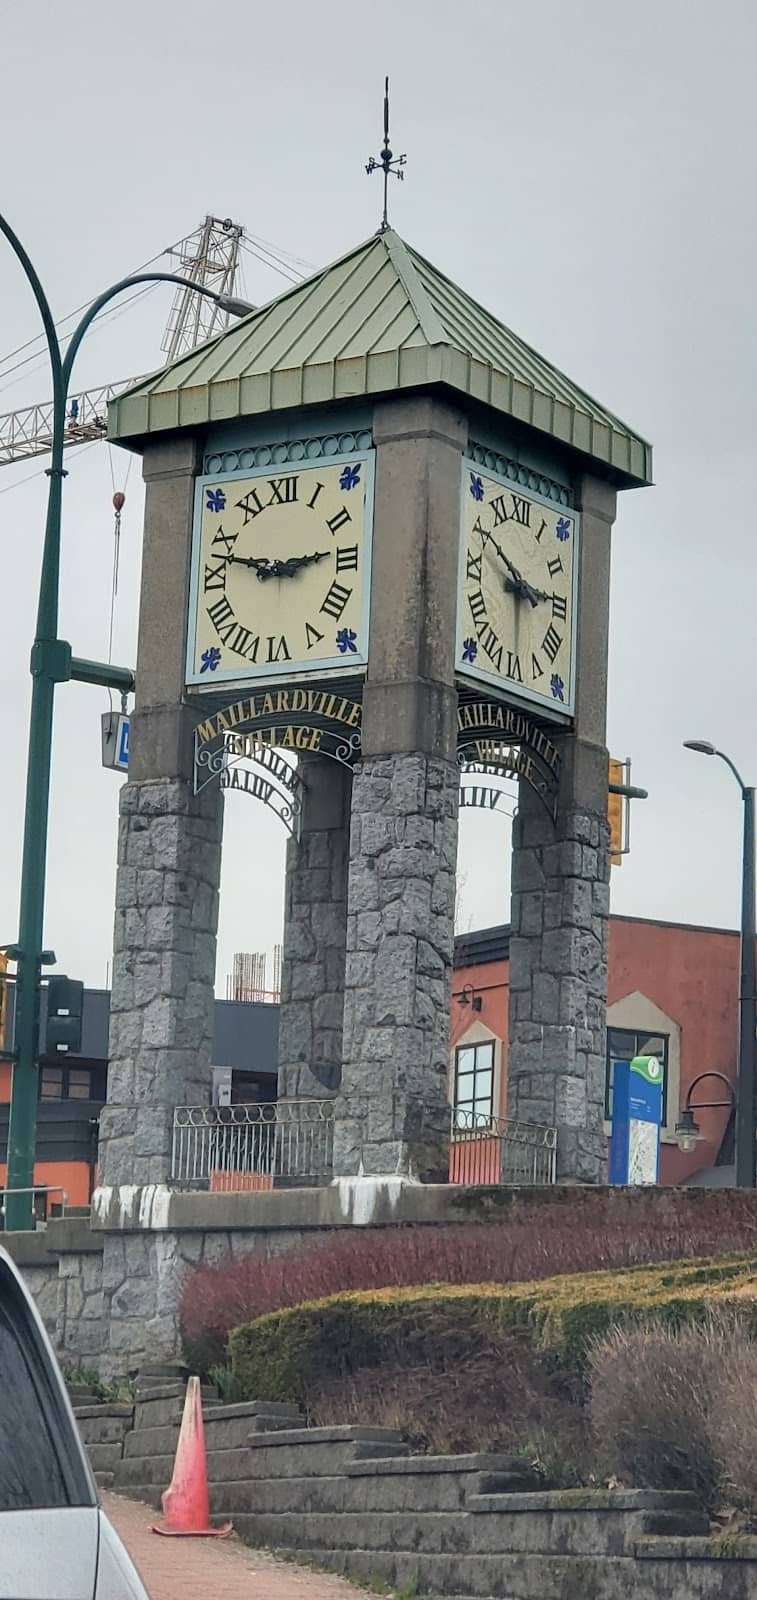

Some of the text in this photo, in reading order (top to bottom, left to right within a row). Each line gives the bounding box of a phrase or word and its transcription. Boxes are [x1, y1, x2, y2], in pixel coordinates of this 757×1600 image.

[234, 488, 266, 526] XI
[267, 476, 299, 506] XII
[307, 482, 325, 509] I
[326, 506, 352, 536] II
[489, 494, 512, 528] XI
[510, 493, 532, 528] XII
[211, 525, 239, 554] X
[535, 518, 548, 544] I
[336, 543, 358, 574] III
[467, 548, 482, 585] IX
[547, 552, 564, 578] II
[204, 560, 226, 594] IX
[319, 579, 352, 622] IIII
[468, 588, 490, 641] VIII
[552, 591, 567, 624] III
[206, 595, 238, 646] VIII
[305, 622, 325, 649] V
[228, 626, 260, 663] VII
[265, 635, 292, 663] VI
[482, 626, 503, 673] VII
[541, 622, 564, 665] IIII
[506, 650, 523, 683] VI
[532, 652, 544, 680] V
[196, 688, 363, 744] MAILLARDVILLE
[232, 725, 324, 756] VILLAGE
